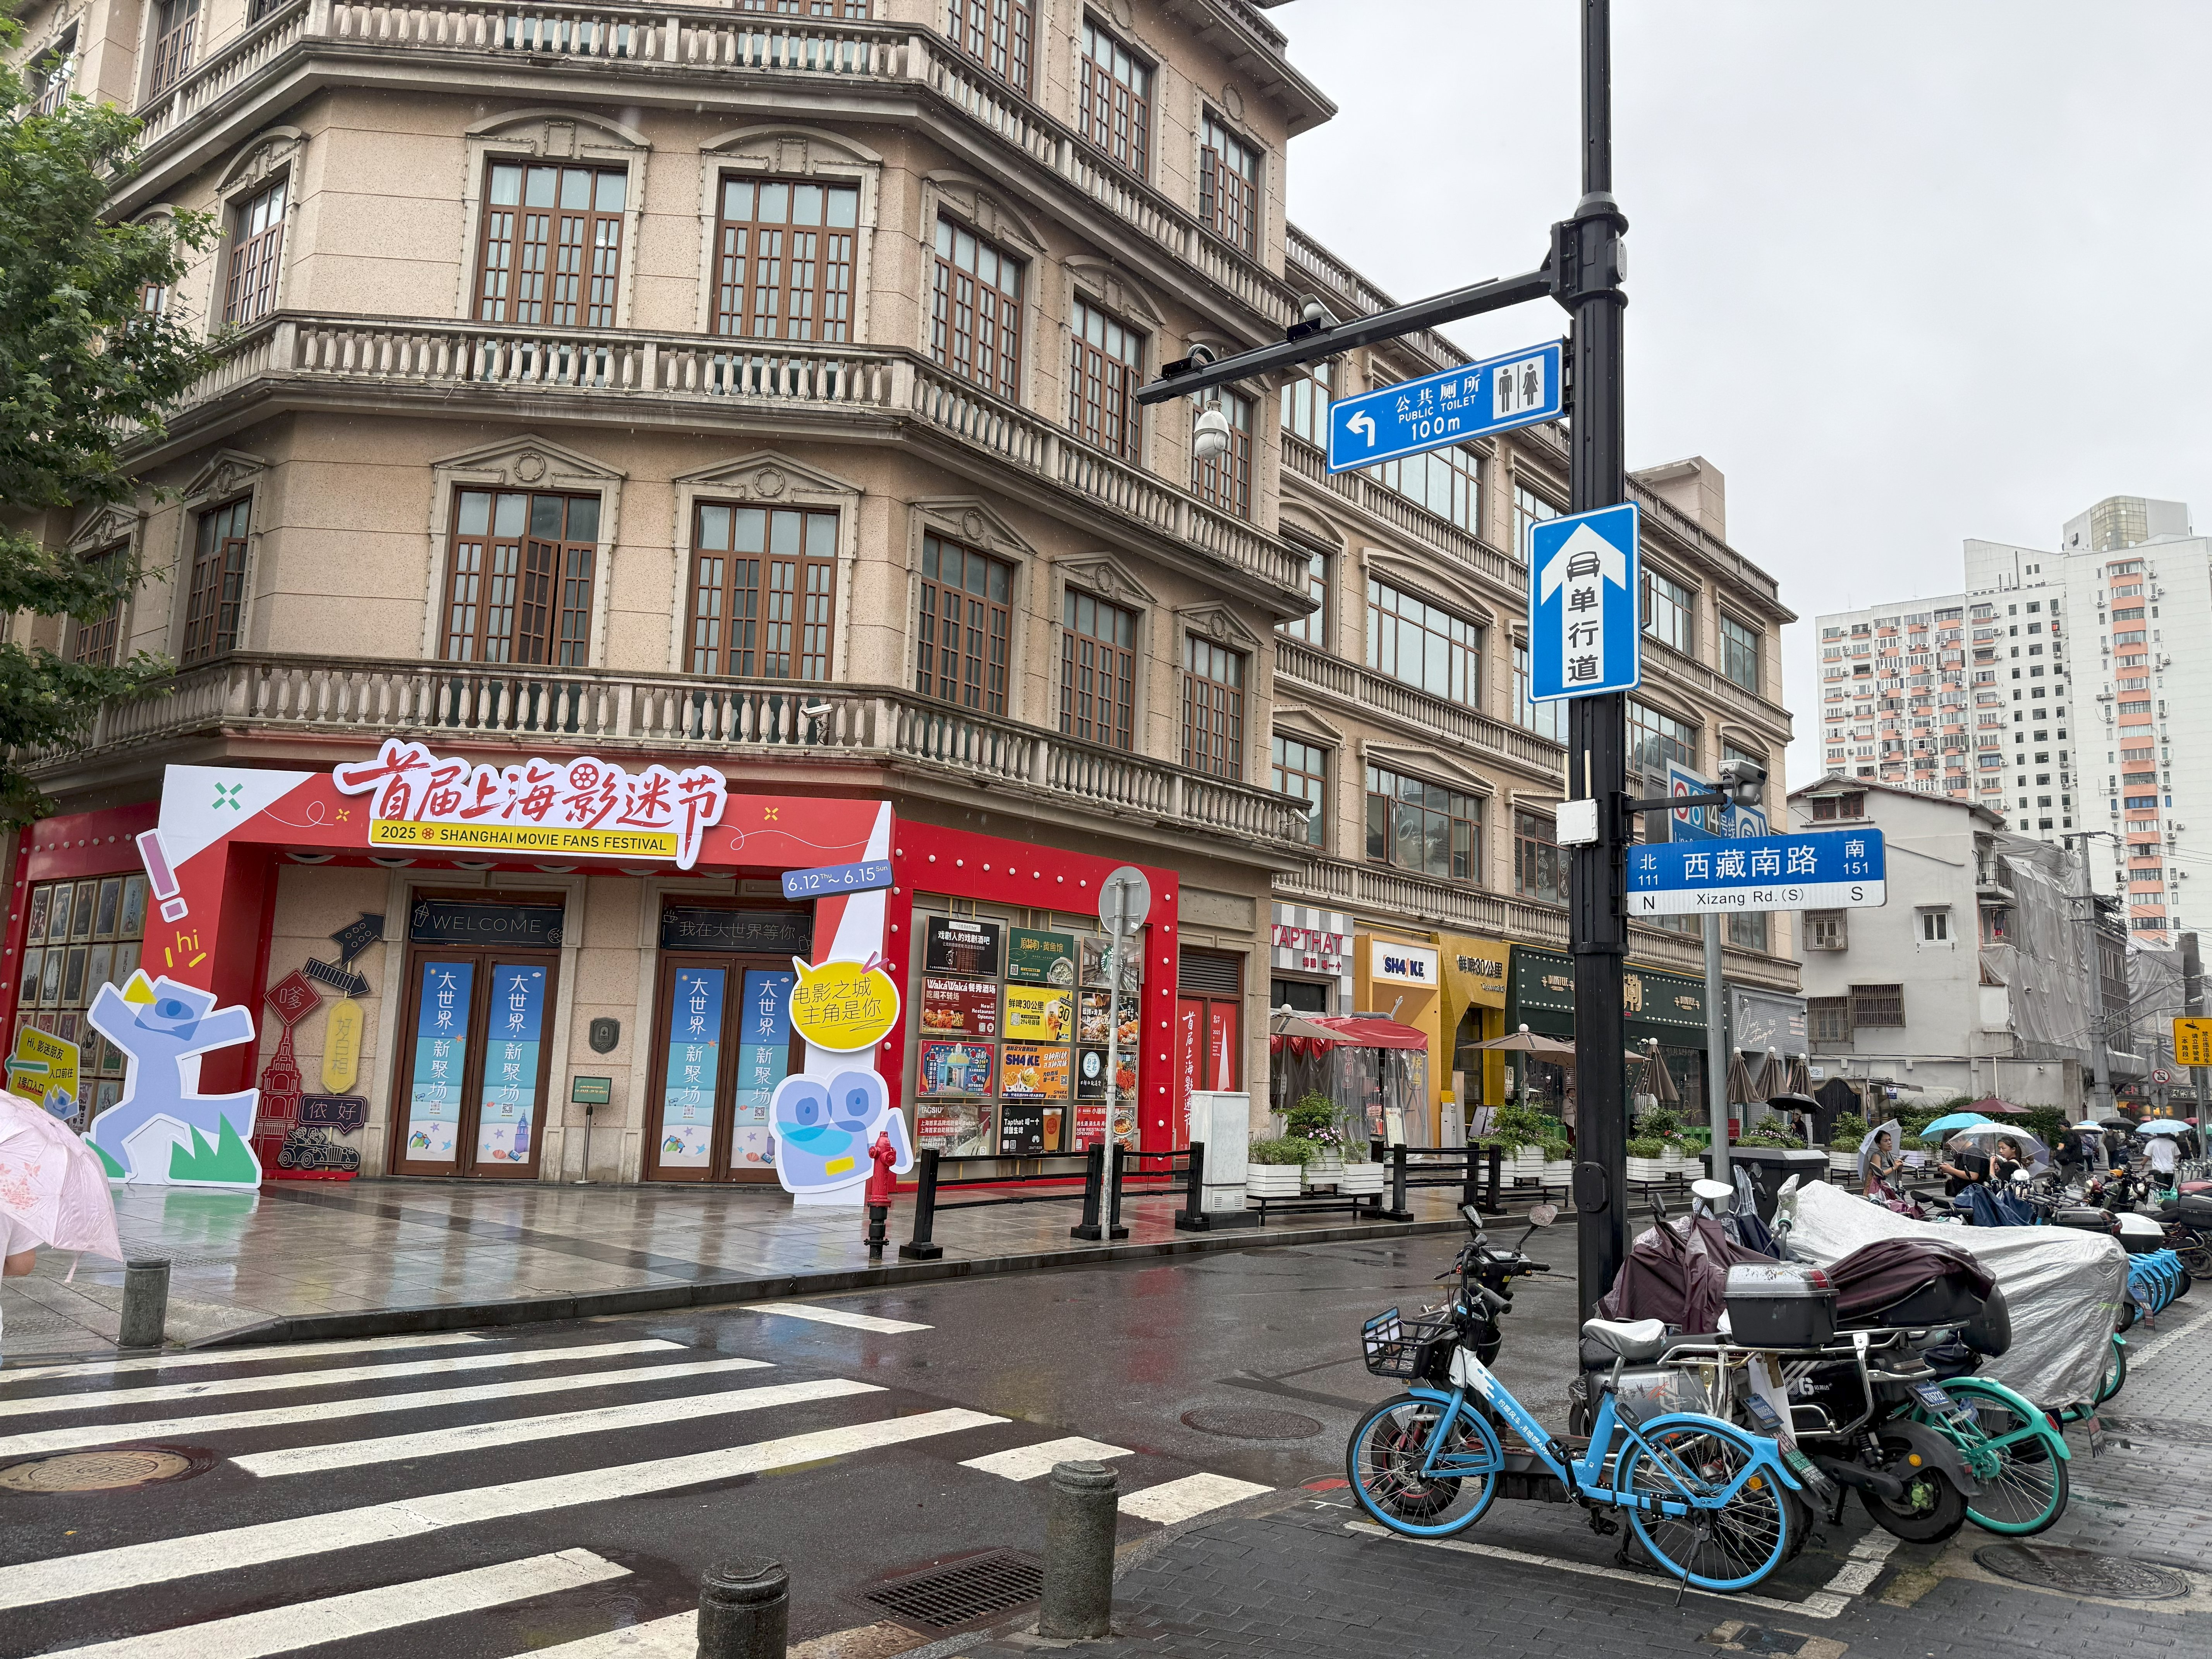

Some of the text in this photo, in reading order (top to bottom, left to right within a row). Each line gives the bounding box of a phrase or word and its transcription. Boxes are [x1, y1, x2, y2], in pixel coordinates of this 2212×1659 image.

[1395, 373, 1481, 413] 公共厕所
[1398, 394, 1476, 424] PUBLIC TOILET
[1412, 416, 1460, 441] 100m
[1568, 587, 1599, 682] 单行道
[343, 747, 716, 857] 首届上海影迷节
[381, 826, 667, 851] 2025 SHANGHAI MOVIE FANS FESTIVAL
[1845, 839, 1864, 859] 南
[1640, 854, 1657, 871] 北
[1683, 845, 1819, 881] 西藏南路
[1843, 862, 1869, 874] 151
[788, 874, 820, 891] 6.12
[844, 867, 875, 884] 6.15
[1638, 874, 1658, 886] 111
[1644, 895, 1655, 910] N
[1697, 893, 1745, 906] Xizang
[1851, 886, 1863, 901] S
[433, 914, 541, 933] WELCOME
[679, 920, 795, 941] 我在大世界等你
[177, 929, 199, 954] hi
[938, 930, 990, 945] 戏剧人的戏剧酒吧
[1271, 924, 1343, 954] TAPTHAT
[280, 986, 306, 1010] 嗲
[793, 976, 872, 1003] 电影之城
[926, 990, 959, 1001] 吃喝不转场
[802, 997, 882, 1025] 主角是你
[1008, 998, 1044, 1010] 鲜啤30公里
[1058, 1005, 1070, 1022] 30
[332, 1018, 352, 1074] 好白相
[49, 1068, 73, 1079] 入口前往
[1182, 1010, 1196, 1137] 首届上海影迷节
[309, 1101, 356, 1120] 侬好
